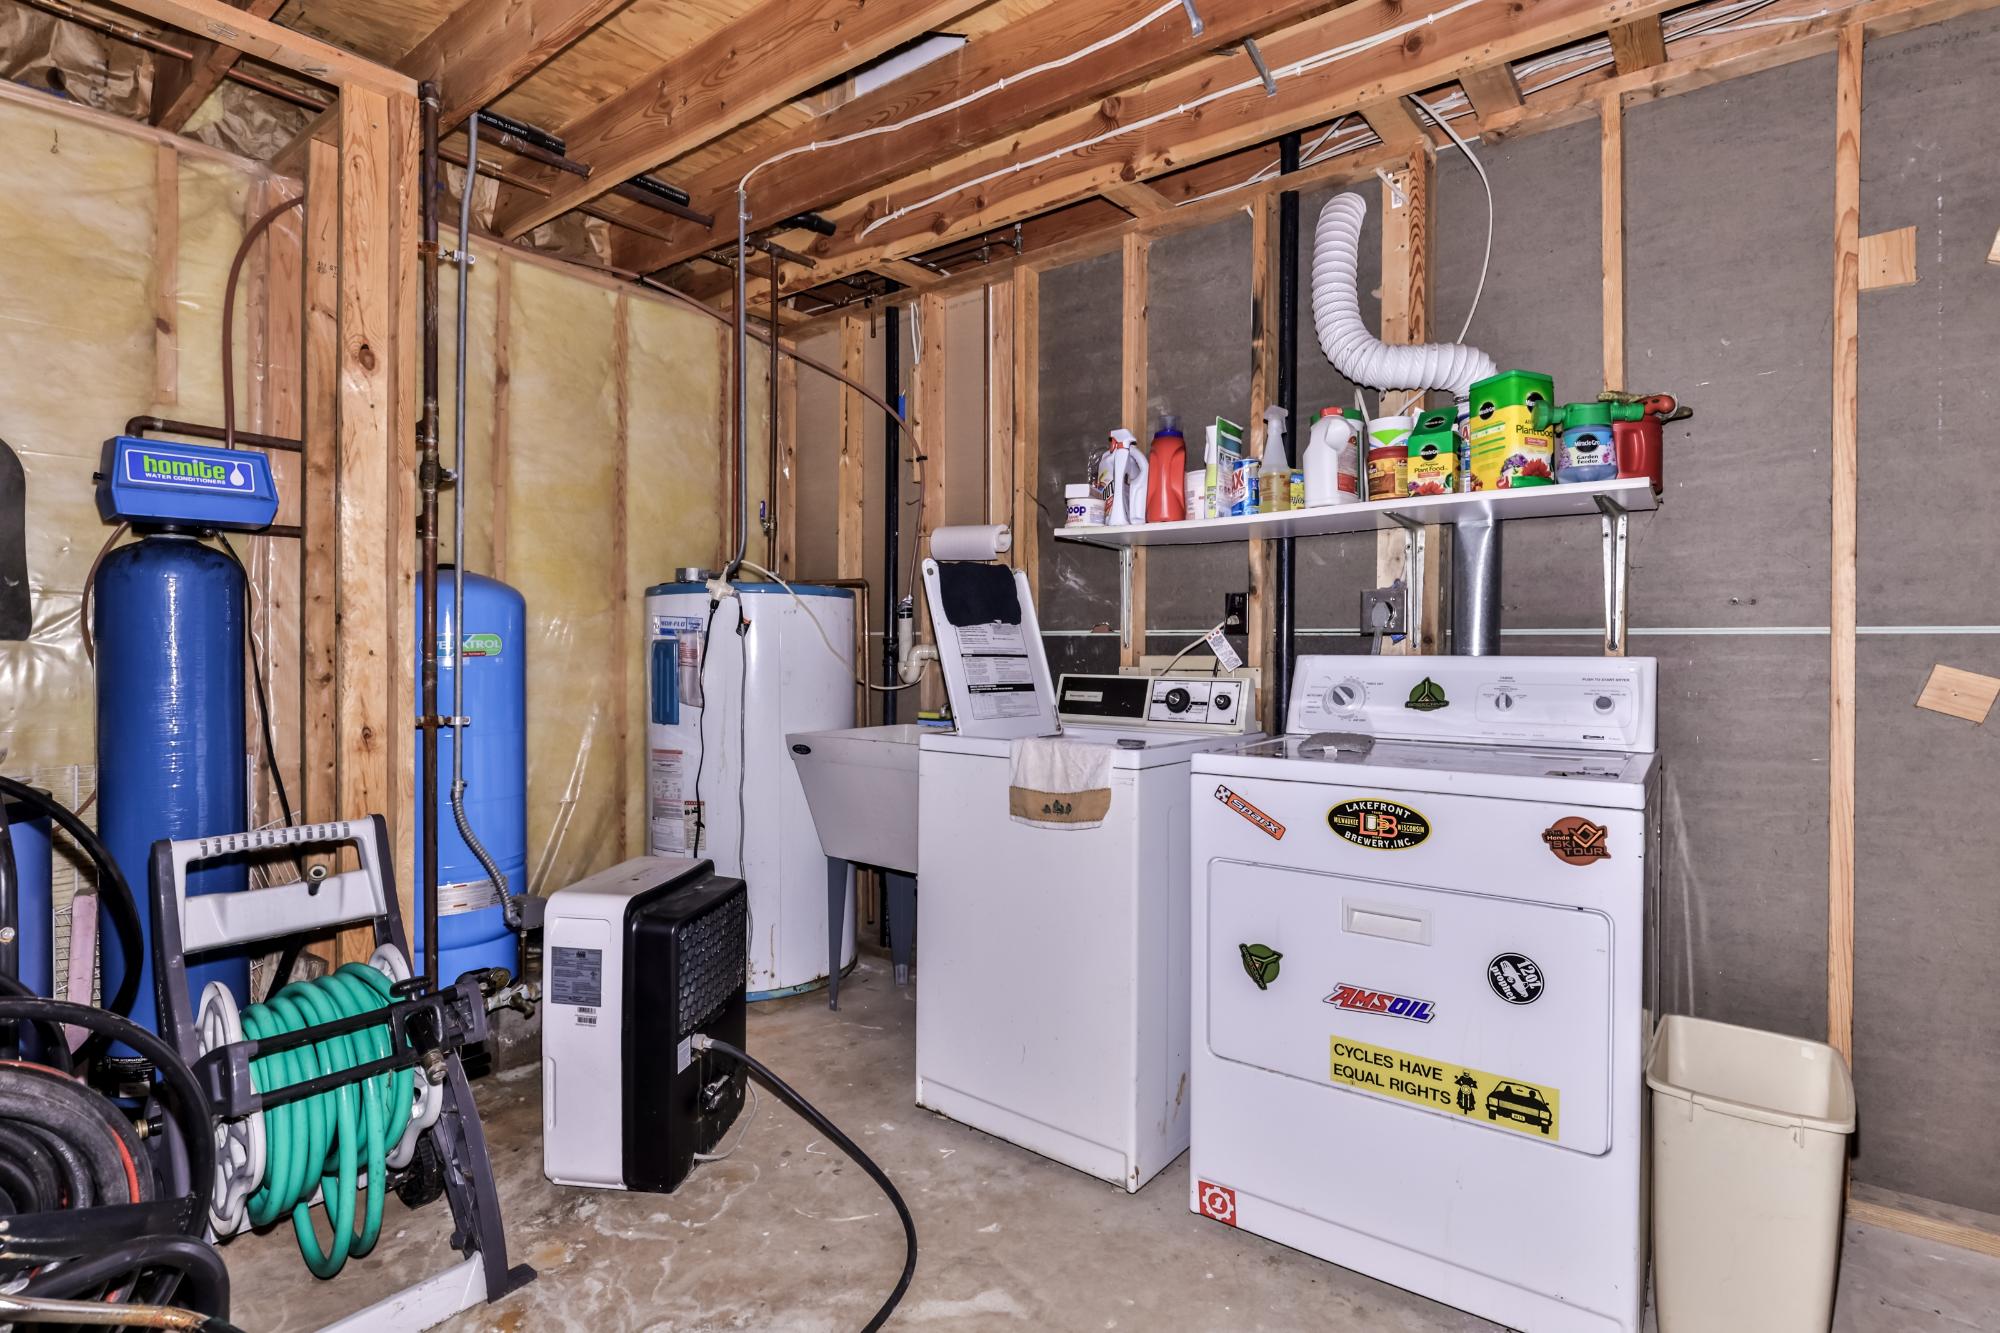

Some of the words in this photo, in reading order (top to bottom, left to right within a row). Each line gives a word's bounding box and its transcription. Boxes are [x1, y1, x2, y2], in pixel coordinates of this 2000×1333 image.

[143, 455, 225, 480] homite
[145, 472, 172, 481] WATER
[173, 475, 226, 485] CONDITIONERS
[1345, 801, 1411, 819] LAKEFRONT
[1333, 816, 1359, 826] MILWAUKEE
[1397, 824, 1425, 834] WISCONSIN
[1564, 847, 1604, 855] TOUR
[1329, 985, 1434, 1021] AMSOIL
[1333, 1043, 1394, 1068] CYCLES
[1399, 1059, 1443, 1082] HAVE
[1333, 1063, 1385, 1087] EQUAL
[1389, 1077, 1452, 1105] RIGHTS
